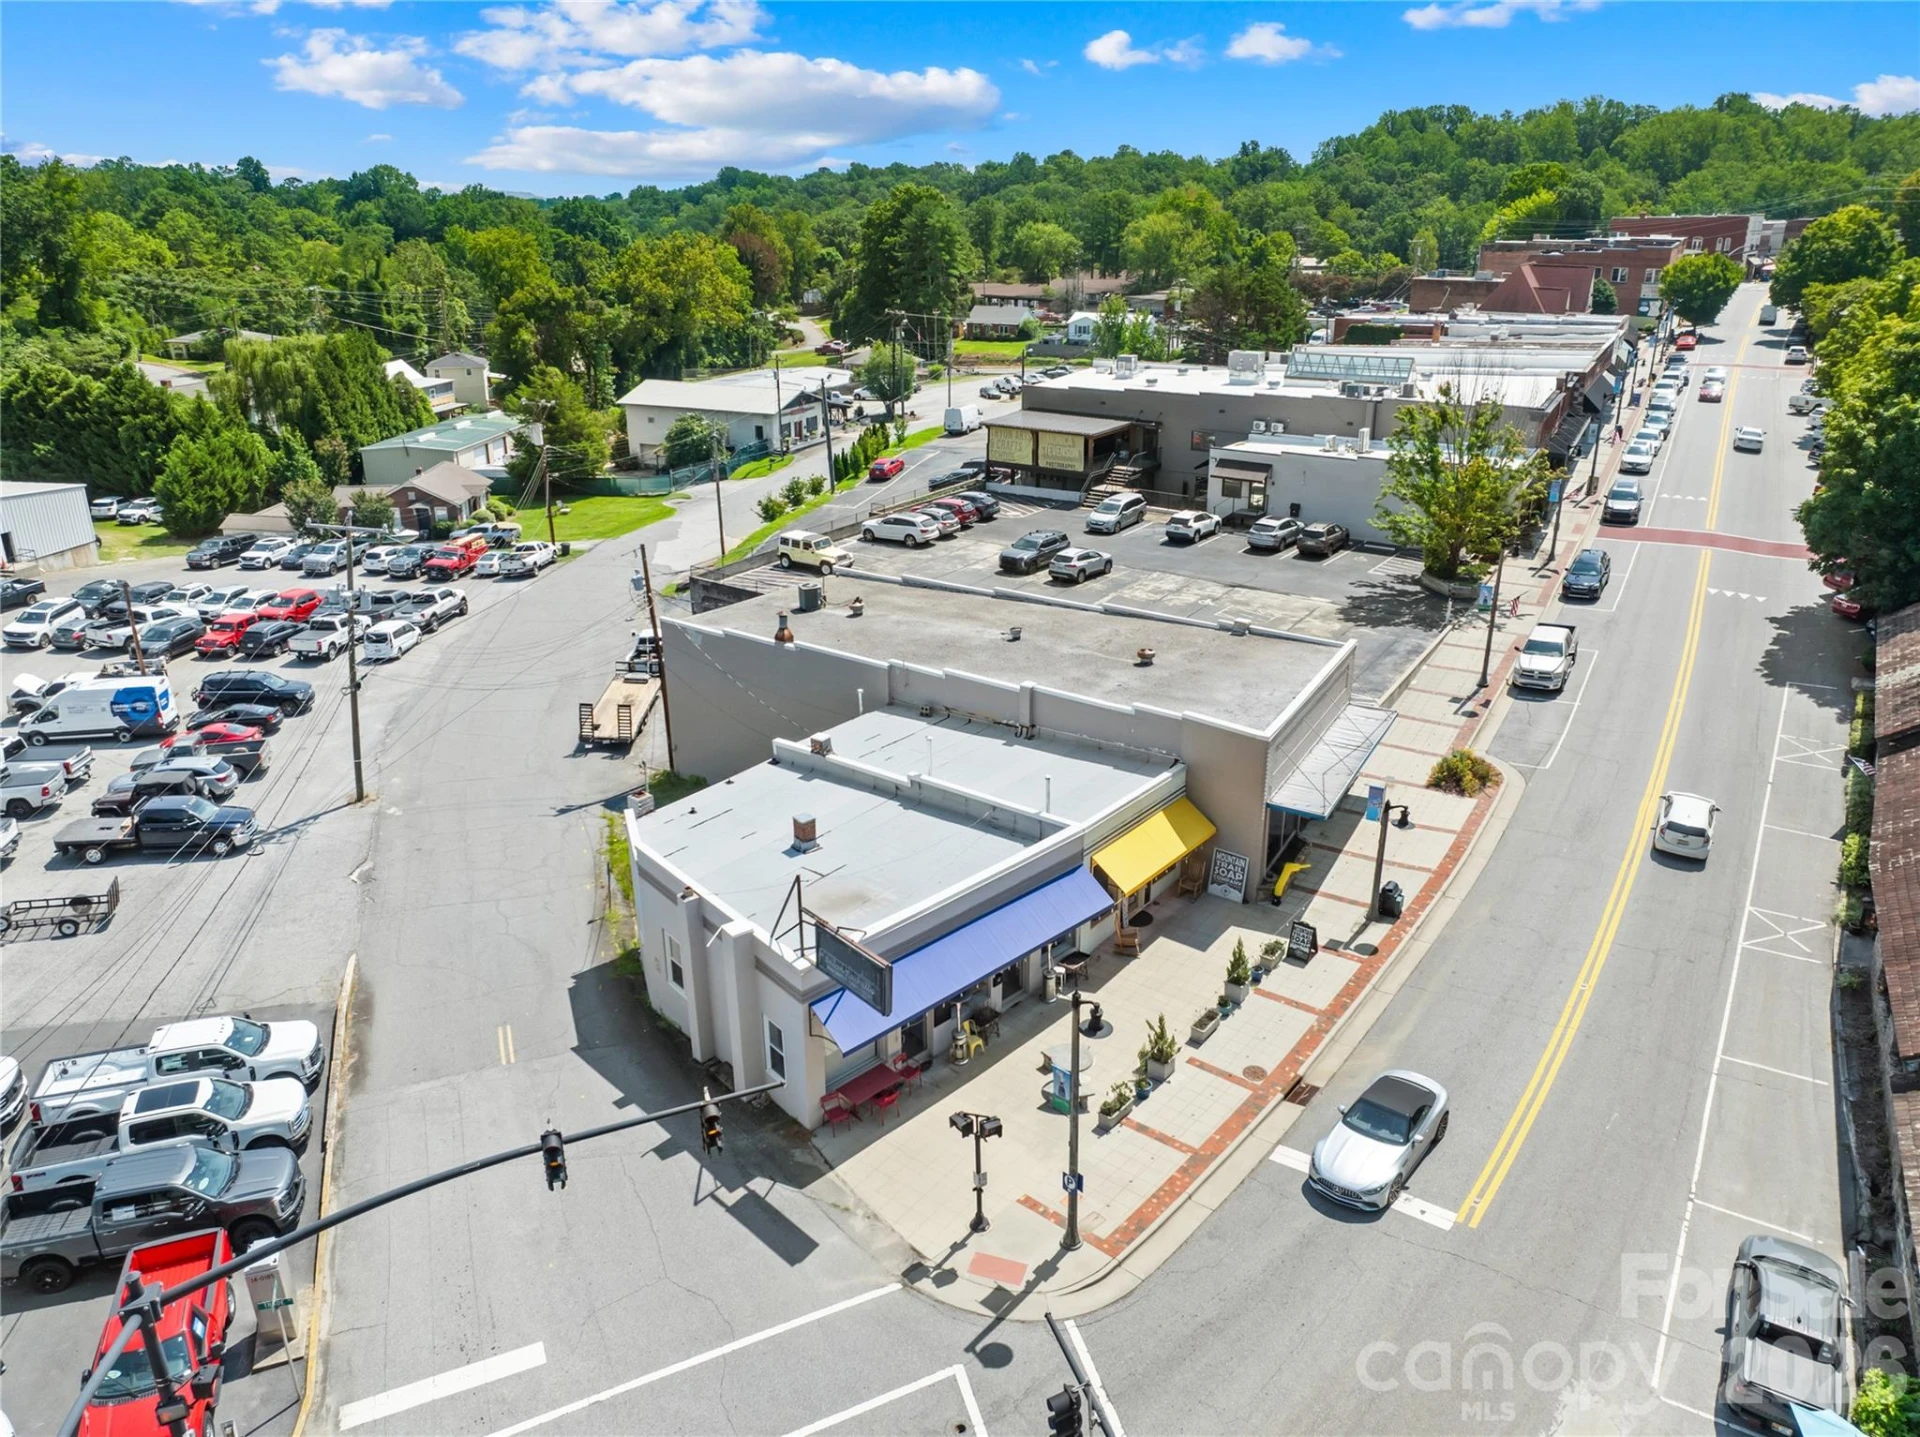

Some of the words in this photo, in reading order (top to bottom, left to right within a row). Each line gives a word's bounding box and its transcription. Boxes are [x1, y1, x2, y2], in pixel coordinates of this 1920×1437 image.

[996, 440, 1023, 452] CRAFTS
[1215, 851, 1245, 868] MOUNTAIN
[1214, 866, 1243, 881] SOAP
[1216, 860, 1243, 874] TRAIL
[1213, 874, 1242, 887] COMPANY
